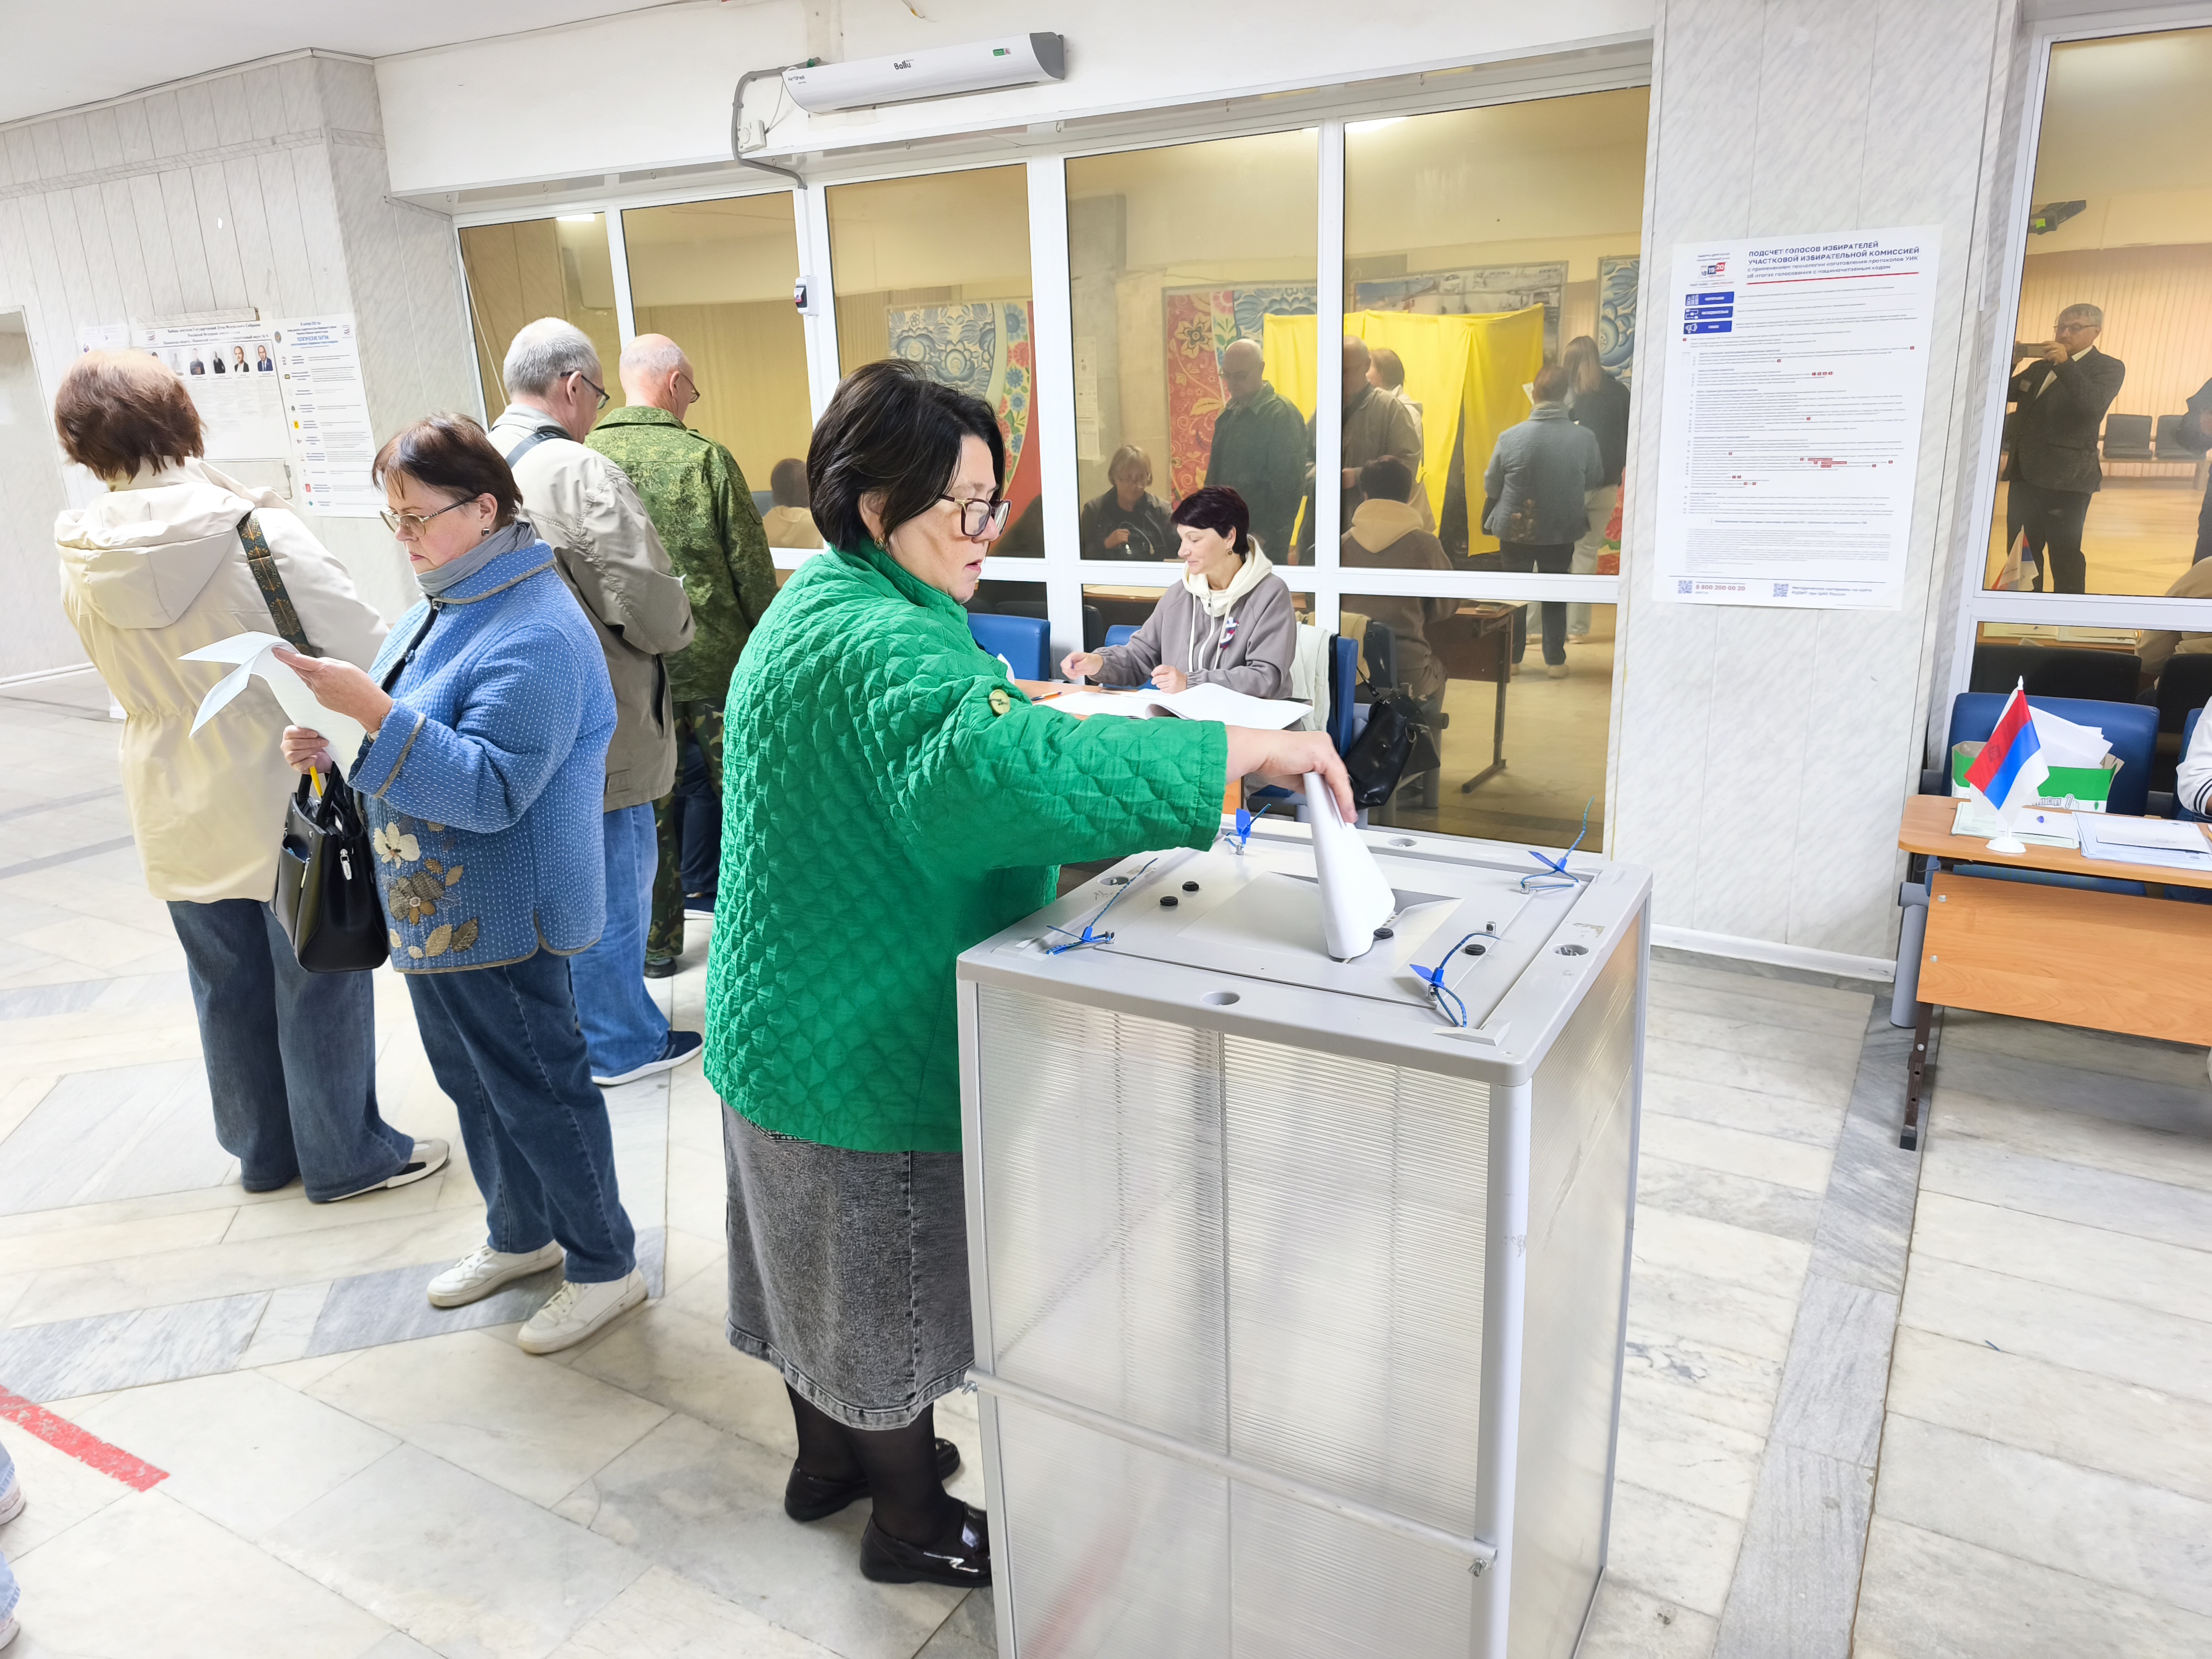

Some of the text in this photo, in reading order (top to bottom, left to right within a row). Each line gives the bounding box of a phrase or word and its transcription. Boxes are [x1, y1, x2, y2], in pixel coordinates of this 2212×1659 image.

[894, 59, 911, 70] Ballu
[1748, 246, 1919, 265] УЧАСТКОВОЙ ИЗБИРАТЕЛЬНОЙ КОМИССИЕЙ
[1749, 240, 1878, 257] ПОДСЧЕТ ГОЛОСОВ ИЗБИРАТЕЛЕЙ
